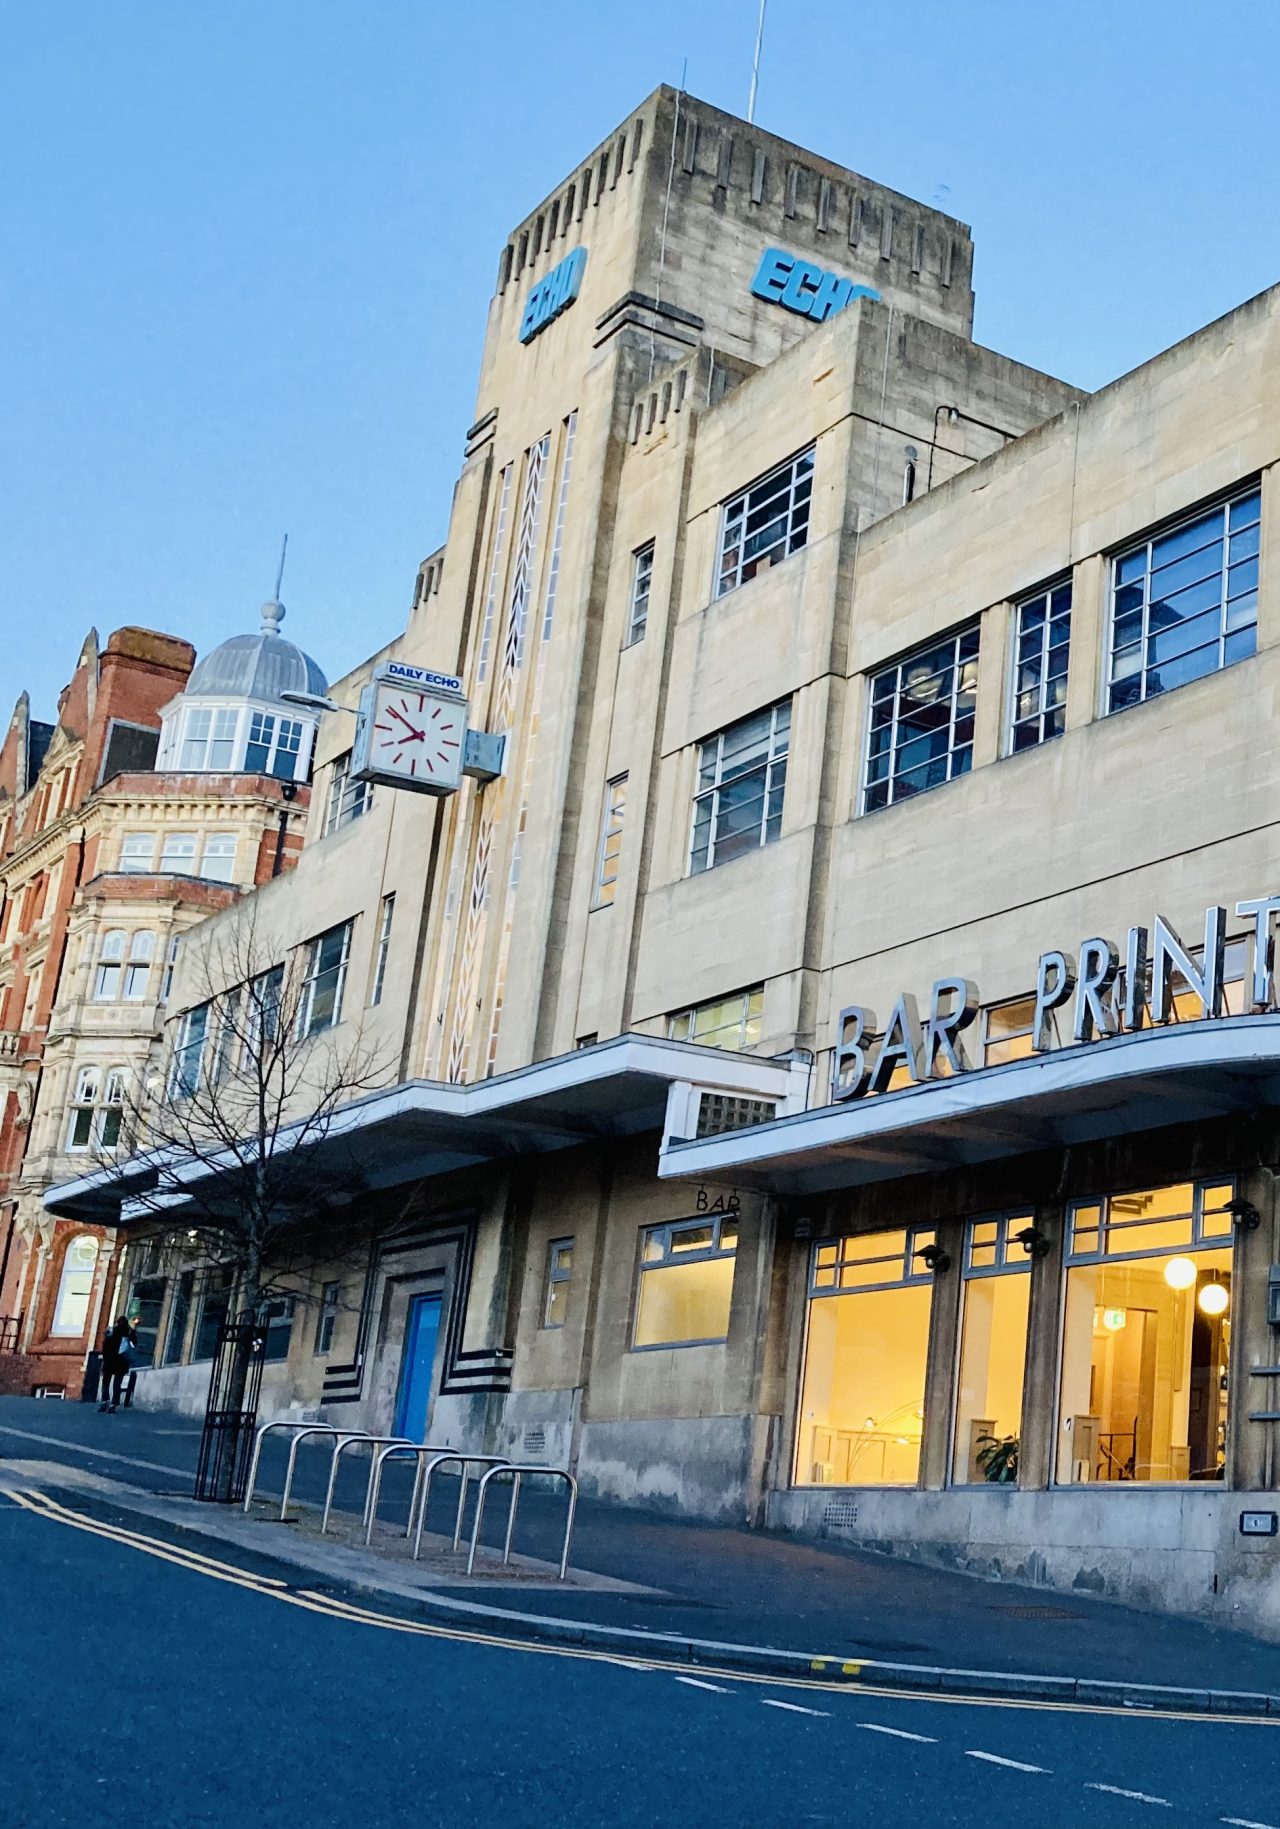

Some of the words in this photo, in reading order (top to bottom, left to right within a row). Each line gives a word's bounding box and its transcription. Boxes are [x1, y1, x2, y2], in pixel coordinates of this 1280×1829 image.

[519, 246, 588, 344] ECHO
[388, 664, 423, 680] DAILY
[425, 673, 460, 689] ECHO
[833, 977, 979, 1101] BAR
[696, 1190, 740, 1213] BAR
